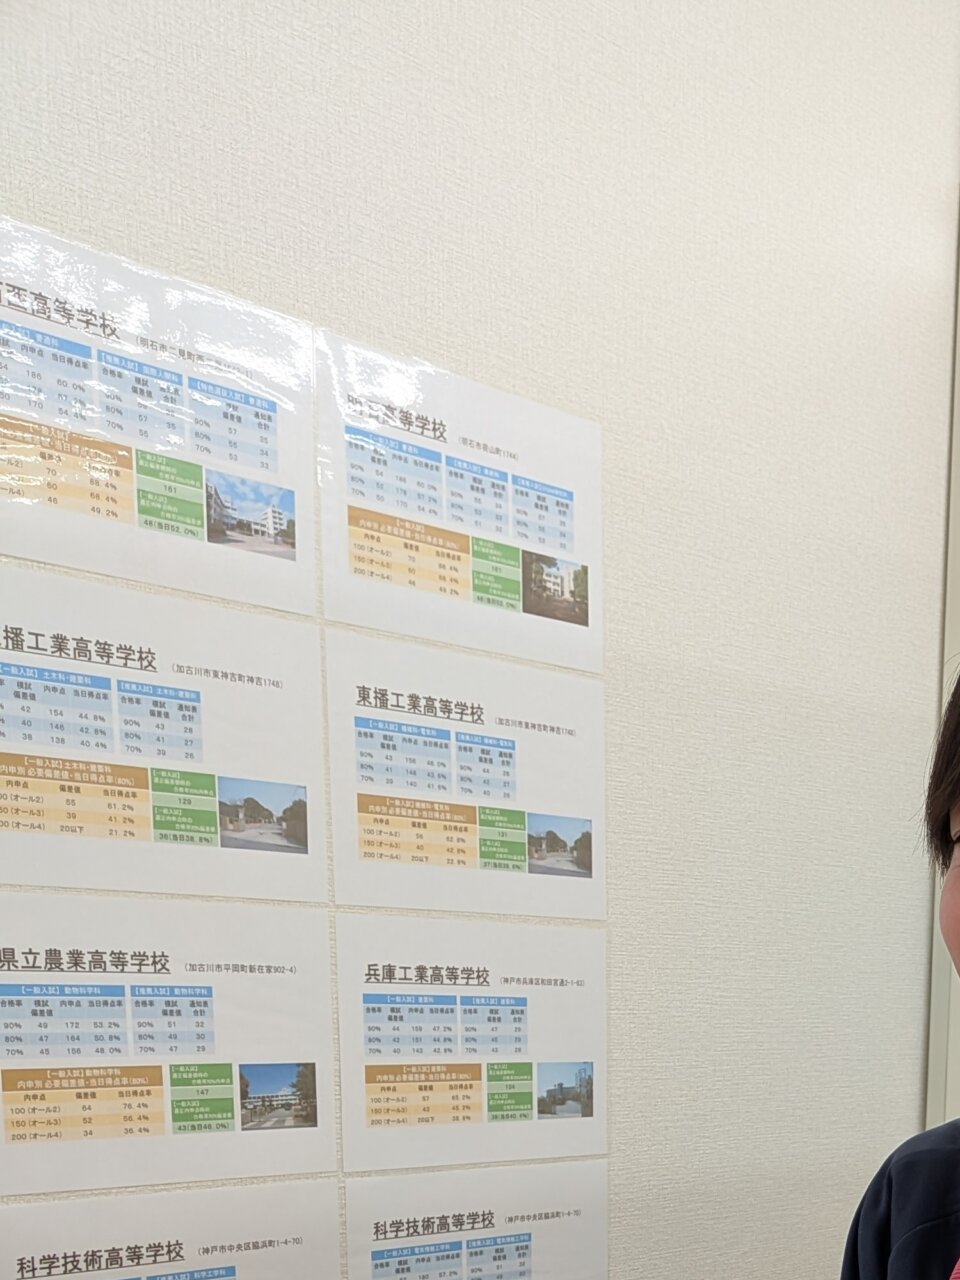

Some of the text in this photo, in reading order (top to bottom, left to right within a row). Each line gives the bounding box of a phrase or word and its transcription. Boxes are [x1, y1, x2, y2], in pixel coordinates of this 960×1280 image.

[0, 624, 157, 670] 播工業高等学校
[356, 685, 485, 724] 東播工業高等学校
[20, 705, 32, 714] 42
[21, 719, 32, 728] 40
[123, 718, 165, 731] 90% 43
[124, 744, 143, 754] 70%
[364, 963, 490, 985] 兵庫工業高等学校
[3, 1022, 23, 1030] 90%
[64, 1021, 80, 1029] 172
[137, 1021, 154, 1029] 90%
[4, 1035, 23, 1043] 80%
[38, 1035, 49, 1043] 47
[5, 1048, 24, 1056] 70%
[39, 1048, 50, 1056] 45
[168, 1045, 179, 1053] 47
[83, 1129, 94, 1137] 34
[373, 1210, 495, 1239] 科学技術高等学校
[16, 1240, 185, 1278] 科学技術高等学校
